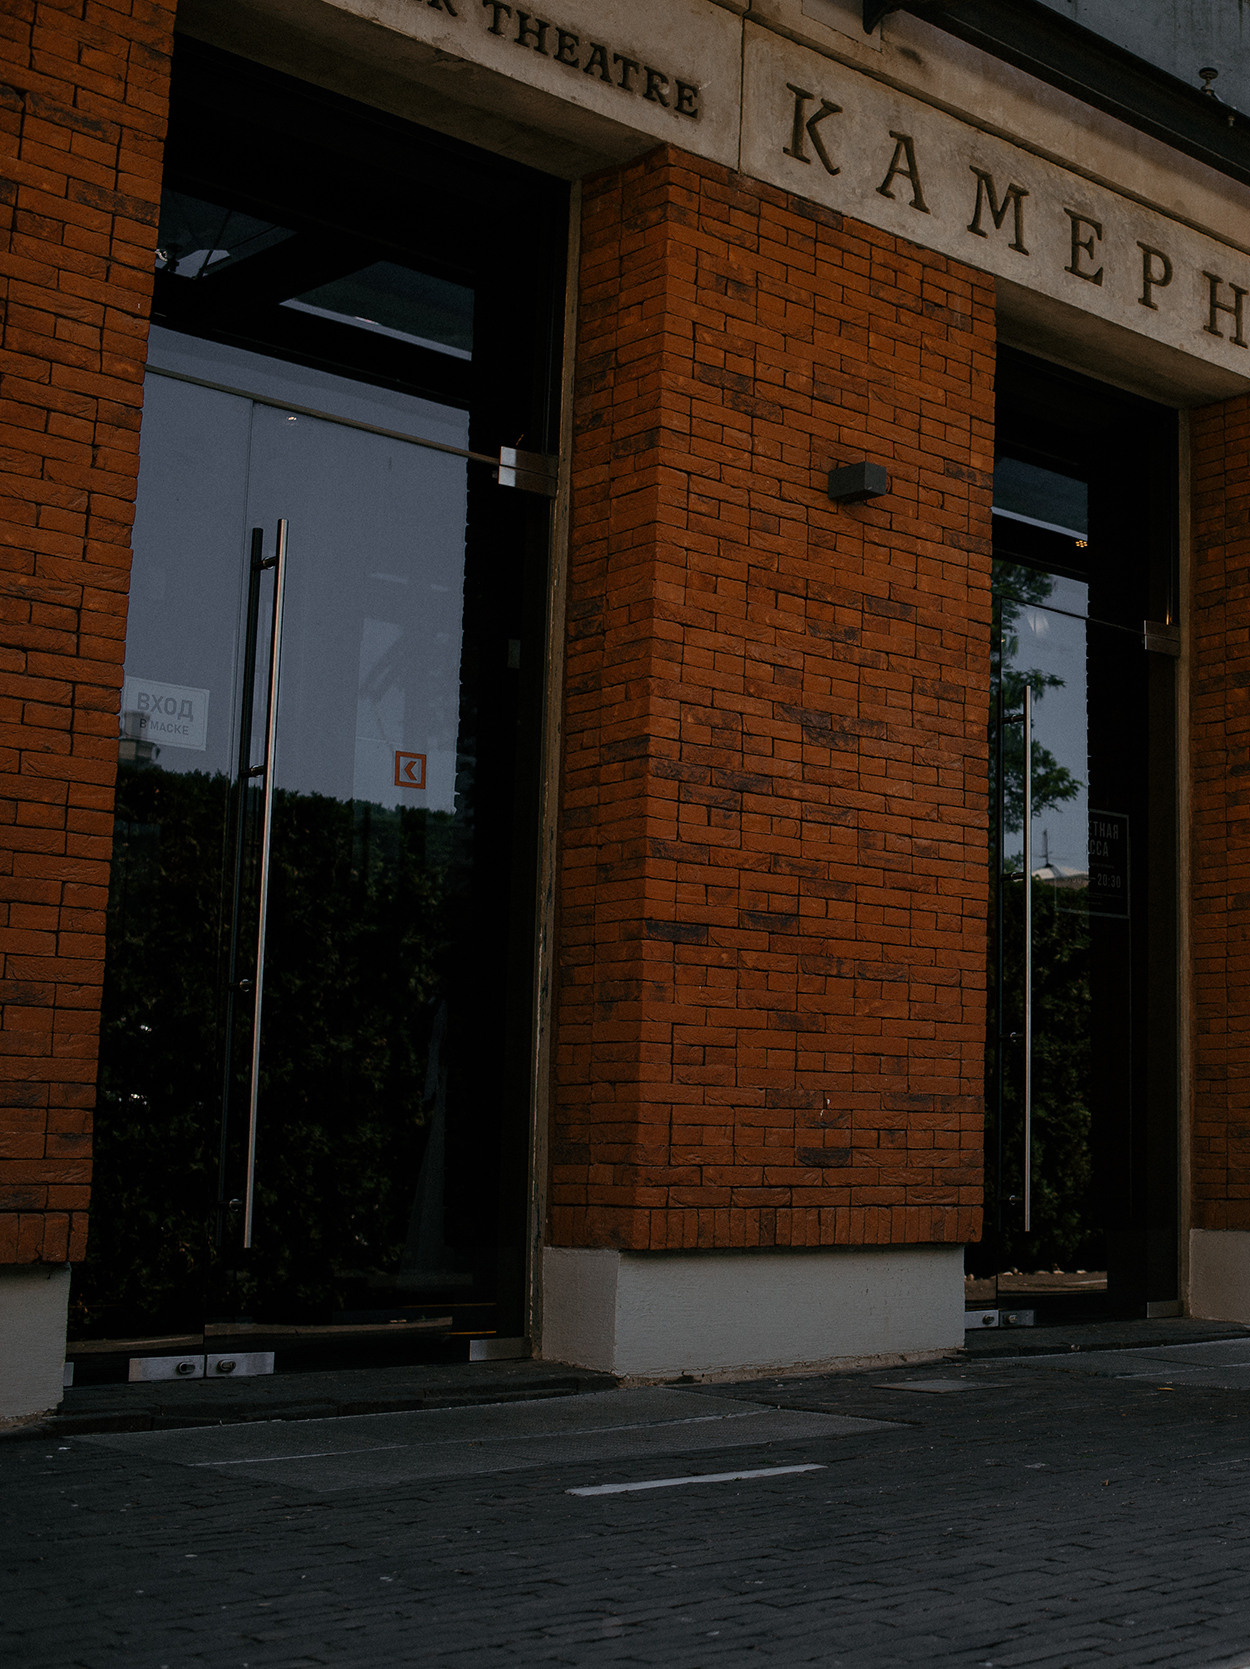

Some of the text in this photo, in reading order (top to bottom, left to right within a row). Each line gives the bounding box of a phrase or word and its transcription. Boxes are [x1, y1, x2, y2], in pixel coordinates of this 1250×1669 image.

[482, 0, 701, 120] THEATRE
[137, 692, 194, 721] ВХОД
[139, 718, 189, 735] В МАСКЕ
[1089, 839, 1109, 857] ССА
